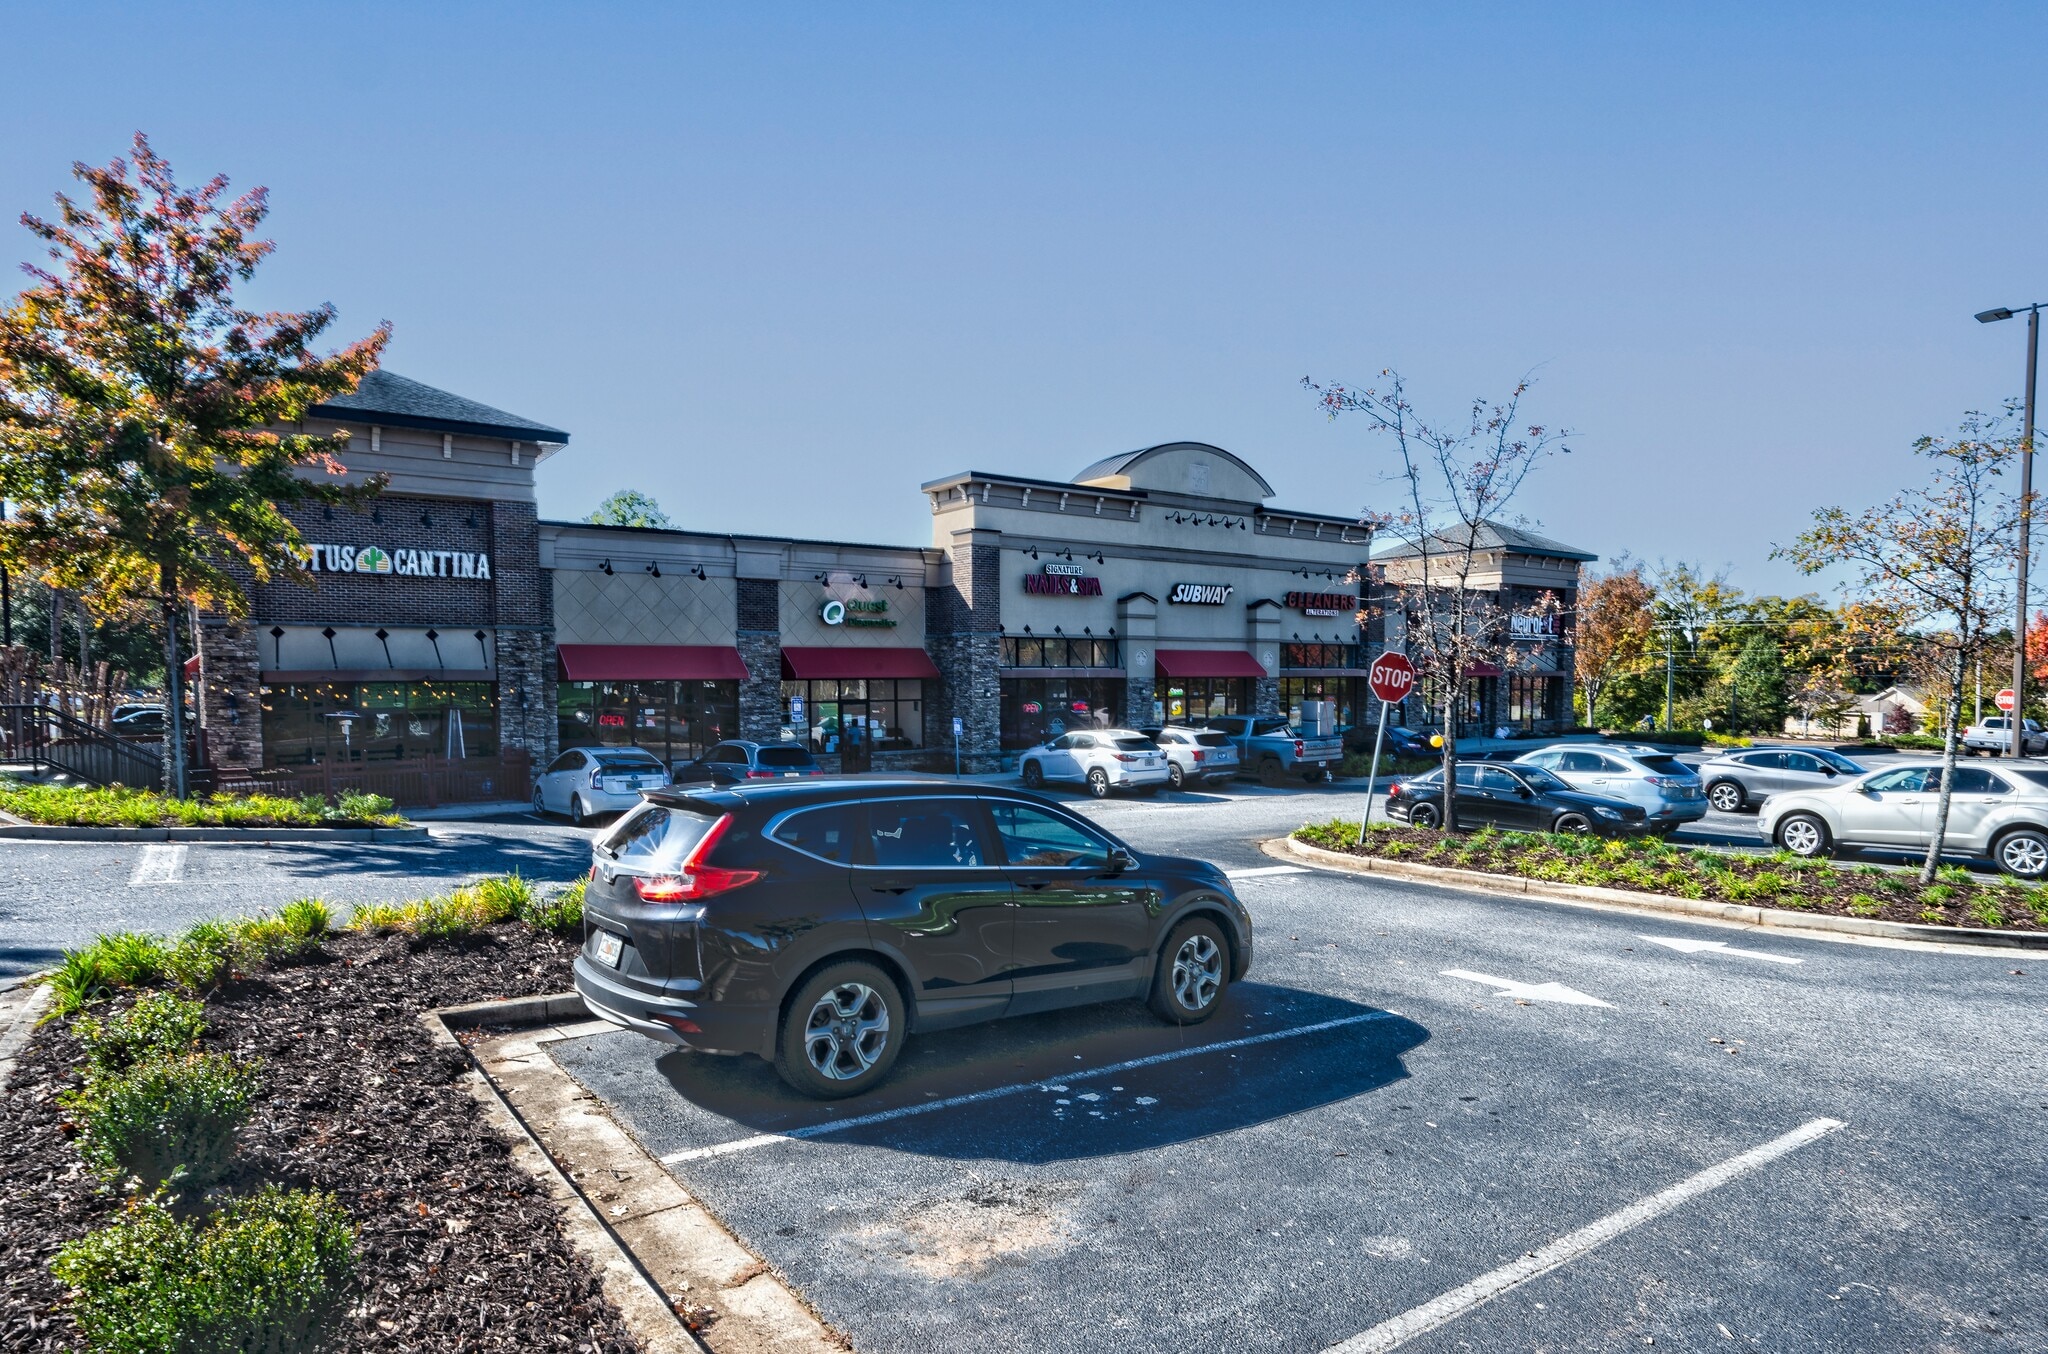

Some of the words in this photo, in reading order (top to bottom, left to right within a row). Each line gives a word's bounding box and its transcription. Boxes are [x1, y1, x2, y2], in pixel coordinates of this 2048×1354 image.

[393, 549, 491, 579] CANTINA
[1046, 564, 1083, 575] SIGNATURE
[1172, 584, 1233, 604] SUBWAY
[1287, 591, 1356, 611] CLEANERS
[846, 599, 888, 612] Quest
[1373, 665, 1411, 689] STOP
[1023, 703, 1039, 713] OPEN
[599, 715, 625, 726] OPEN
